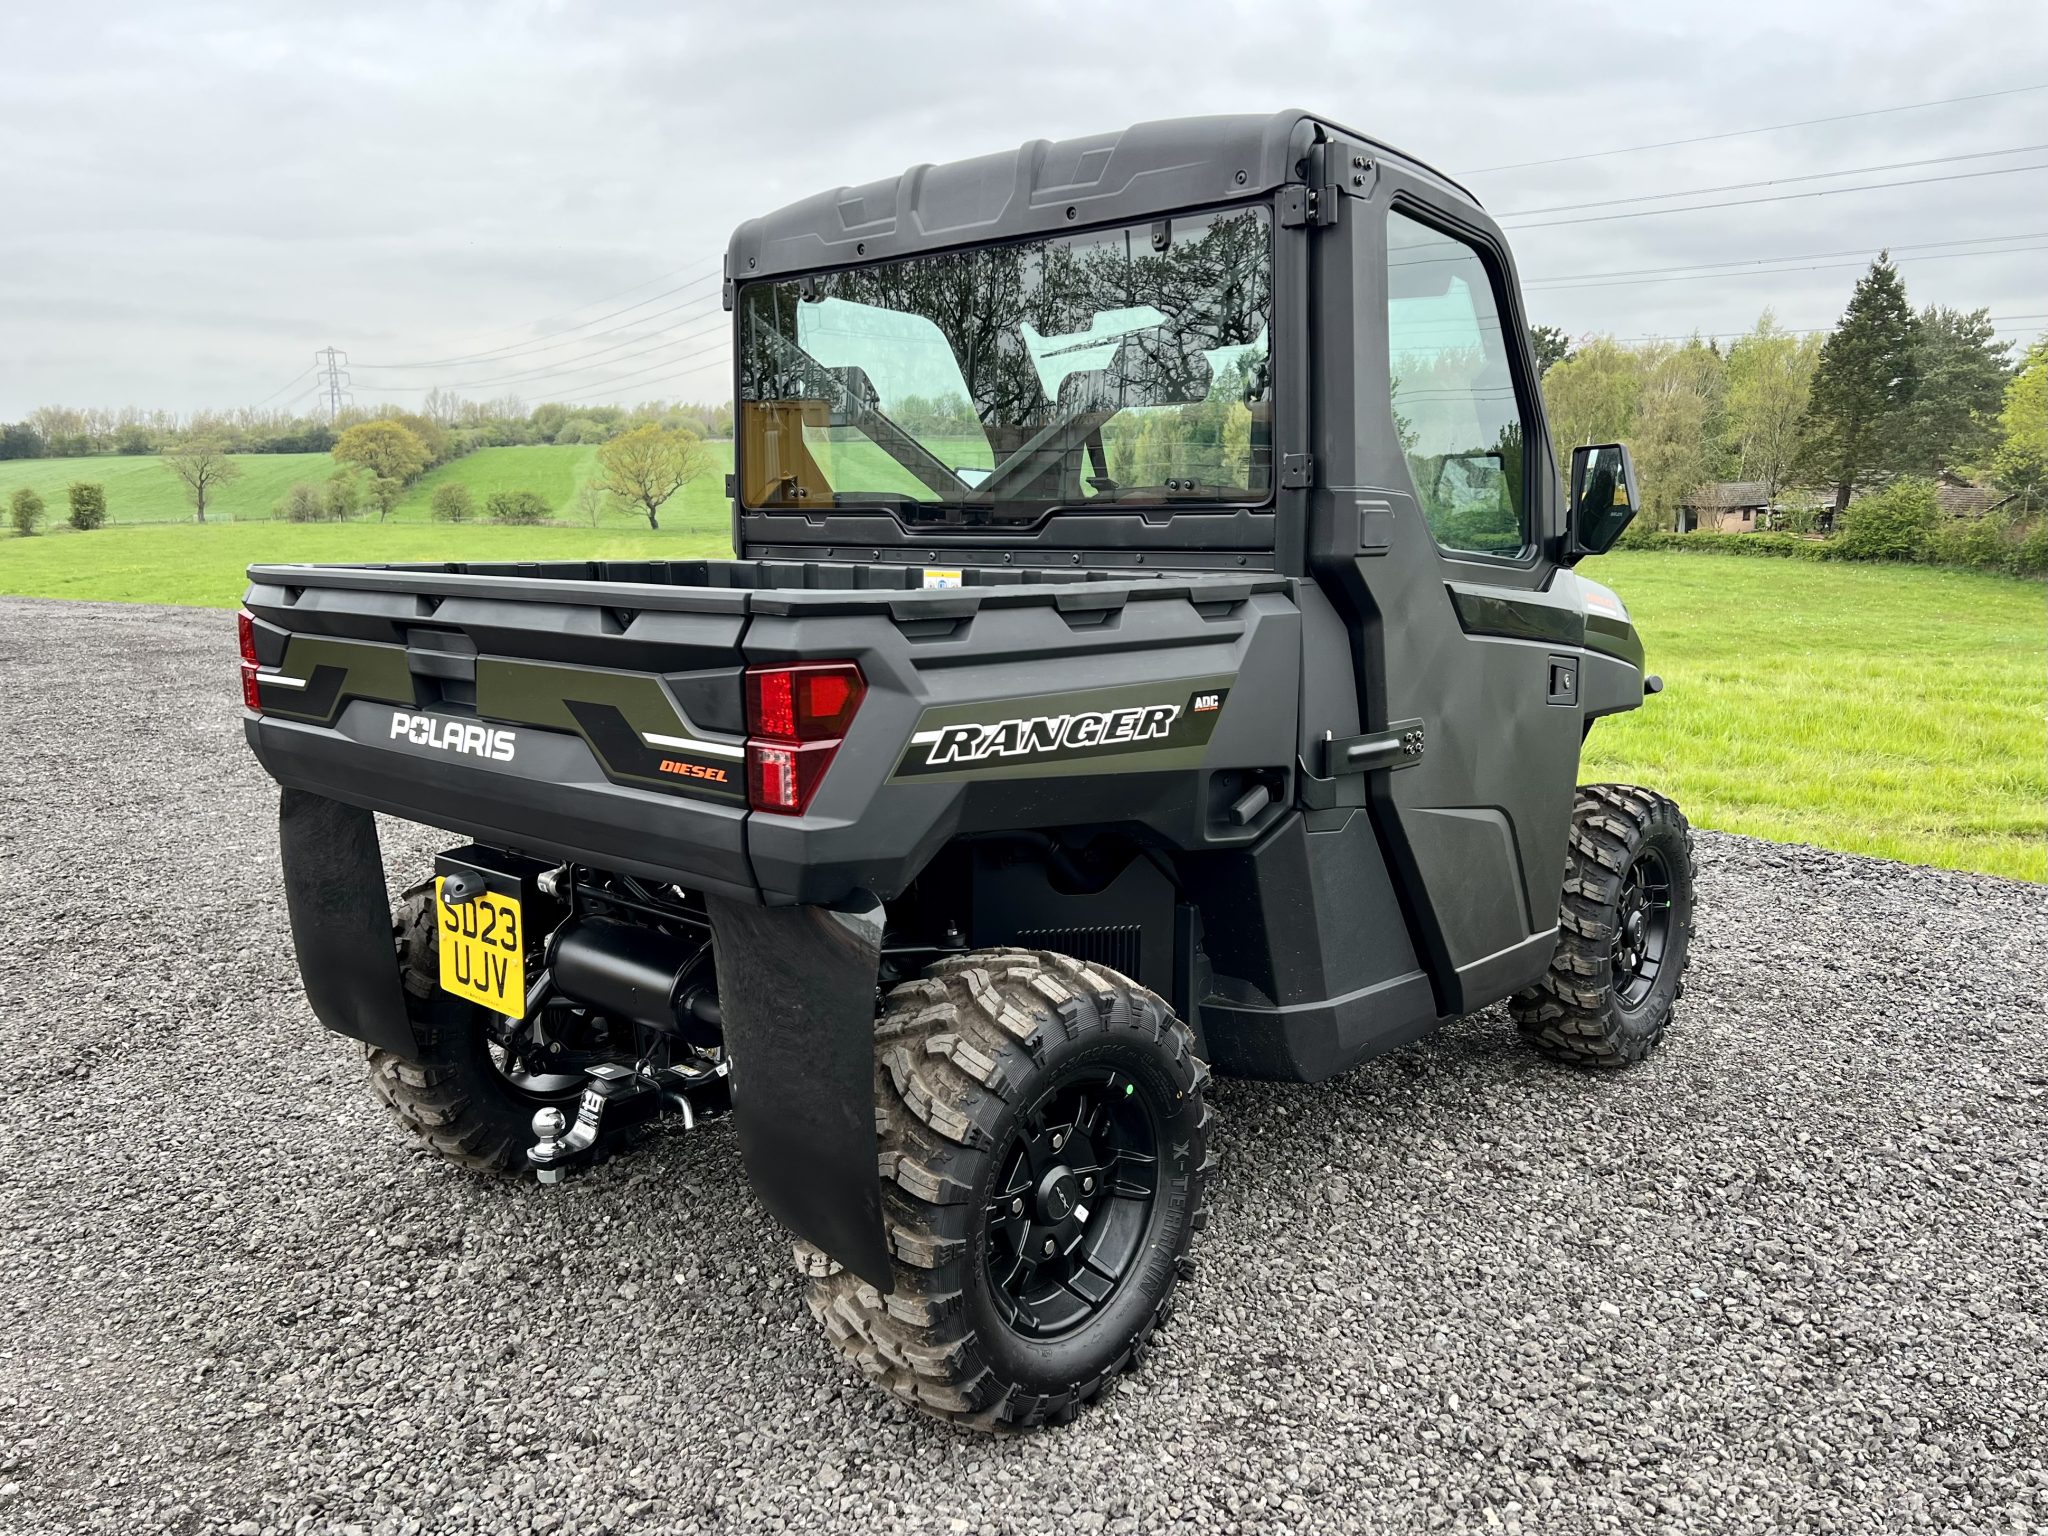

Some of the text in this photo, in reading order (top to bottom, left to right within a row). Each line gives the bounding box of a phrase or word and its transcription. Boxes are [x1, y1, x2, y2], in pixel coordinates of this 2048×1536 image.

[1194, 694, 1219, 709] ADC
[389, 712, 516, 761] POLARIS
[925, 704, 1181, 765] RANGER
[659, 760, 728, 783] DIESEL
[444, 899, 517, 952] SD23
[454, 941, 508, 999] UJV
[1139, 1136, 1191, 1299] X-TERRAIN
